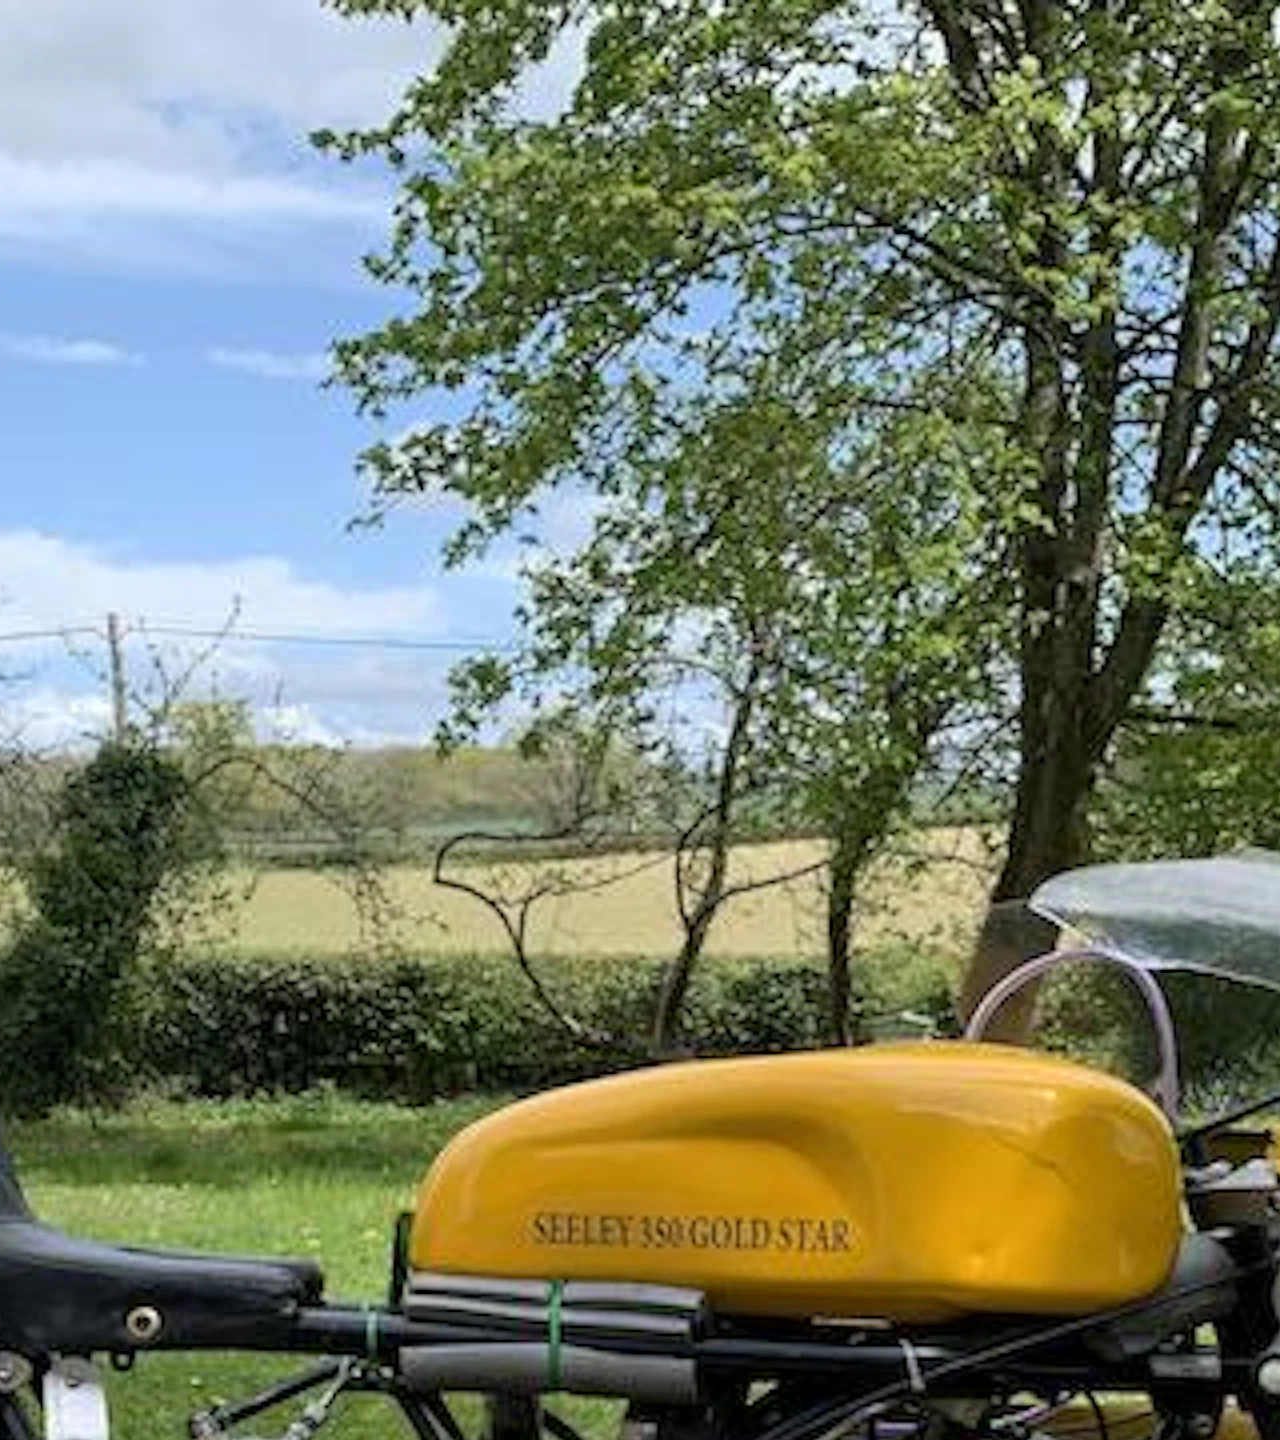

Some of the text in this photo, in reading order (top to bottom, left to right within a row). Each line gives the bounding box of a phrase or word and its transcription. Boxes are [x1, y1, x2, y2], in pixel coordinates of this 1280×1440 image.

[533, 1212, 850, 1252] SEELEY 350 GOLD STAR
